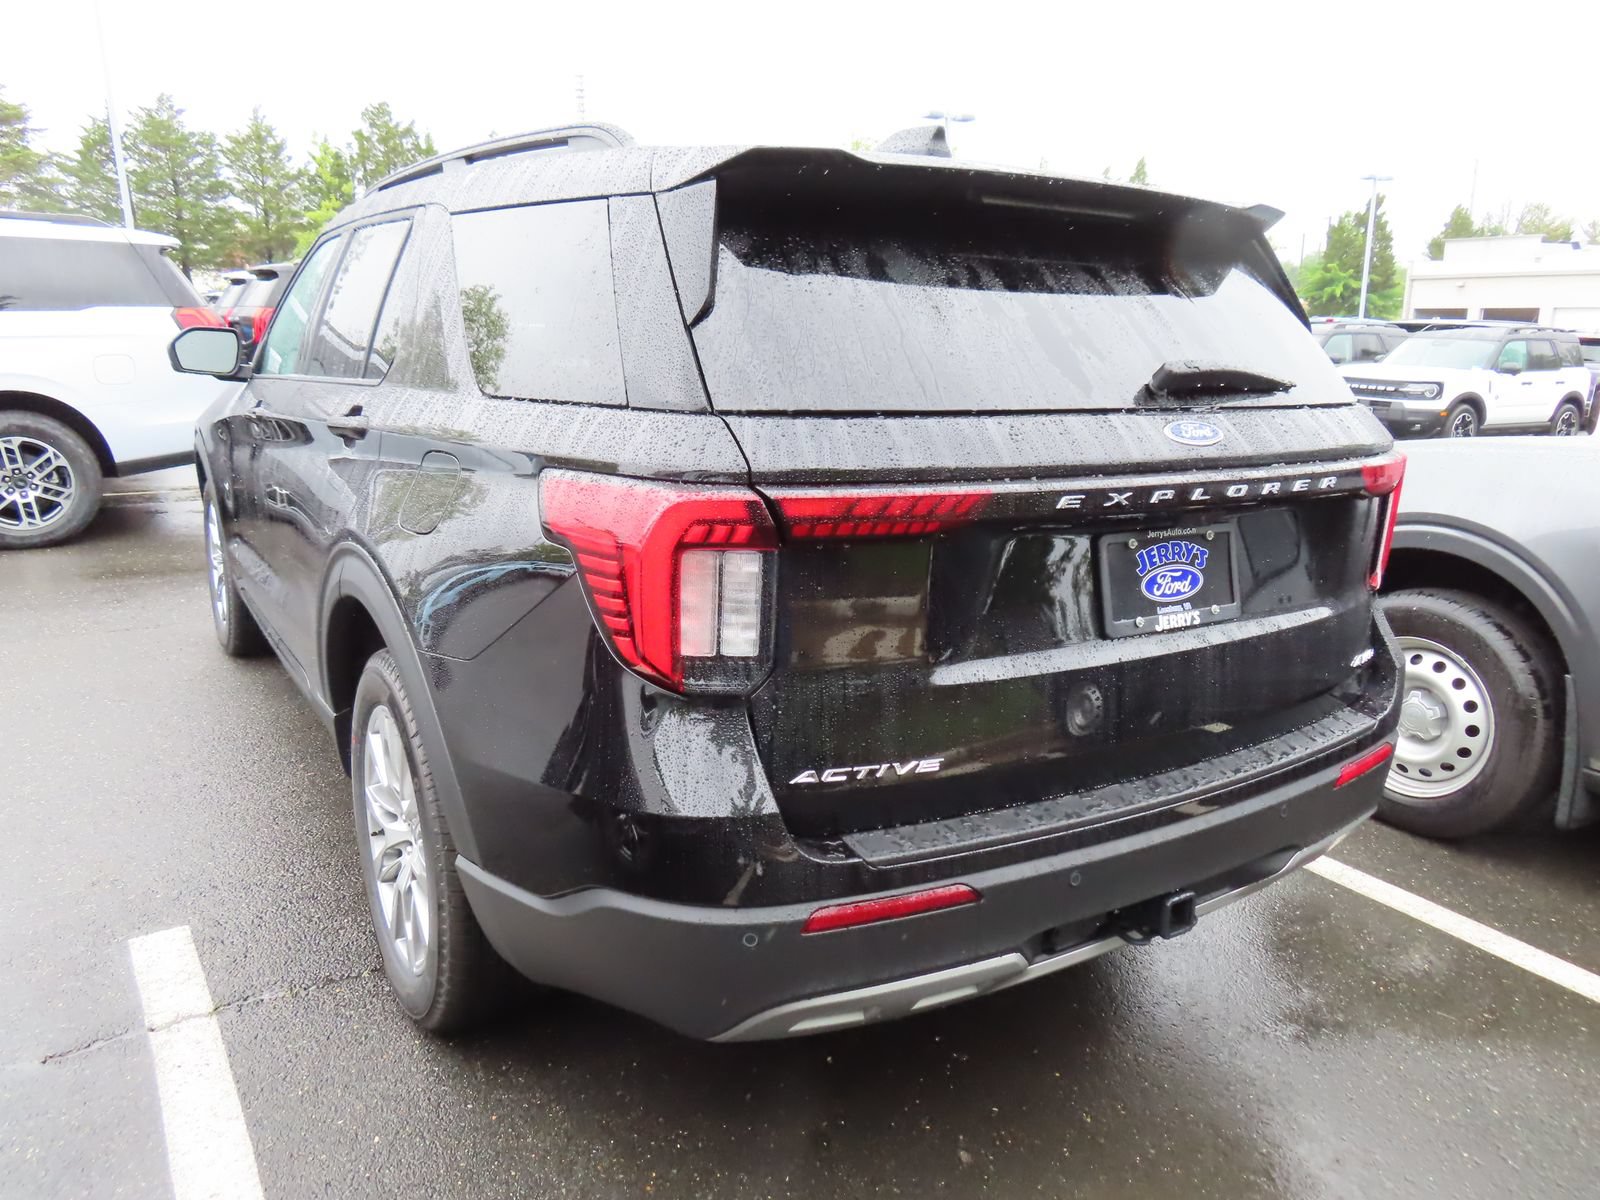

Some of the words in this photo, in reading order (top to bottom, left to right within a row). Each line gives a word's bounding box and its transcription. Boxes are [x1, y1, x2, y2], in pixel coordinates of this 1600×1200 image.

[1055, 475, 1338, 510] EXPLORER
[1147, 527, 1197, 539] JerrysAuto.com
[1136, 540, 1209, 576] JERRY'S
[1153, 570, 1192, 596] Ford
[1155, 609, 1201, 632] JERRY'S
[789, 757, 945, 785] ACTIVE
